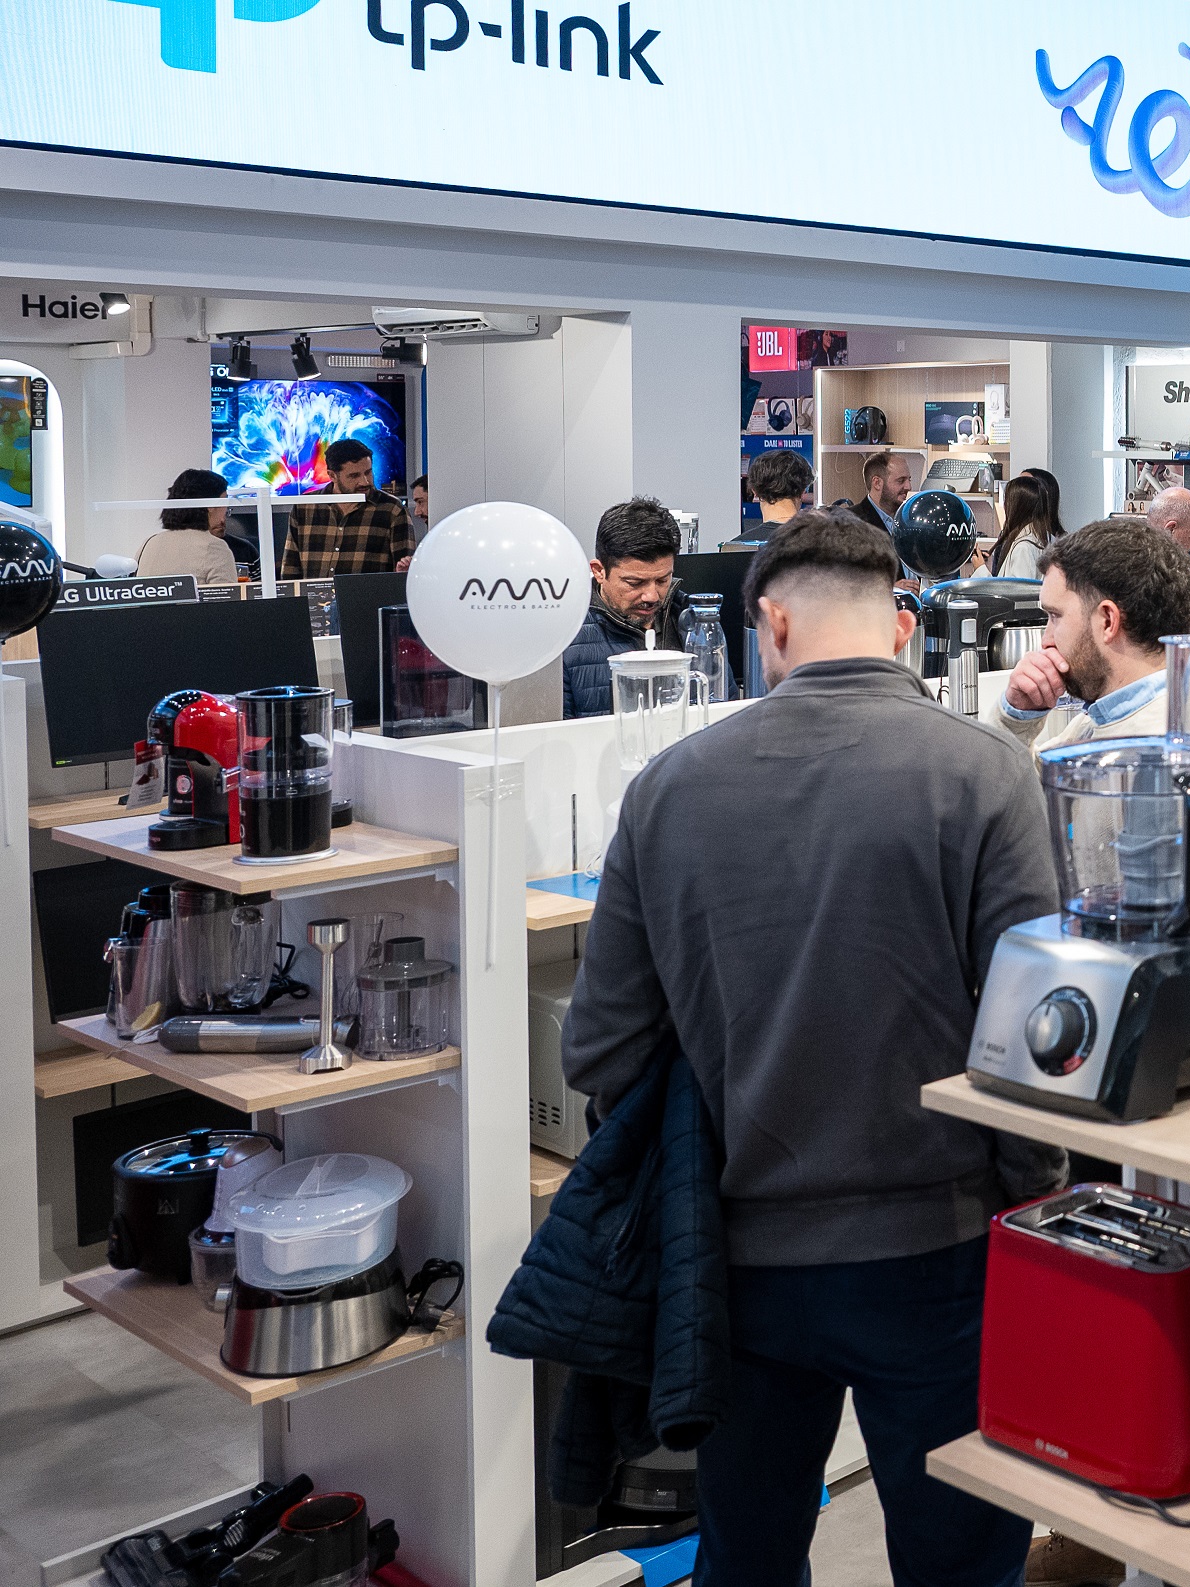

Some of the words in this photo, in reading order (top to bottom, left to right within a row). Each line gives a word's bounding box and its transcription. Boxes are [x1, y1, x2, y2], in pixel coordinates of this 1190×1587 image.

[756, 331, 783, 357] JBL
[0, 558, 54, 579] MV
[458, 577, 570, 601] AMV
